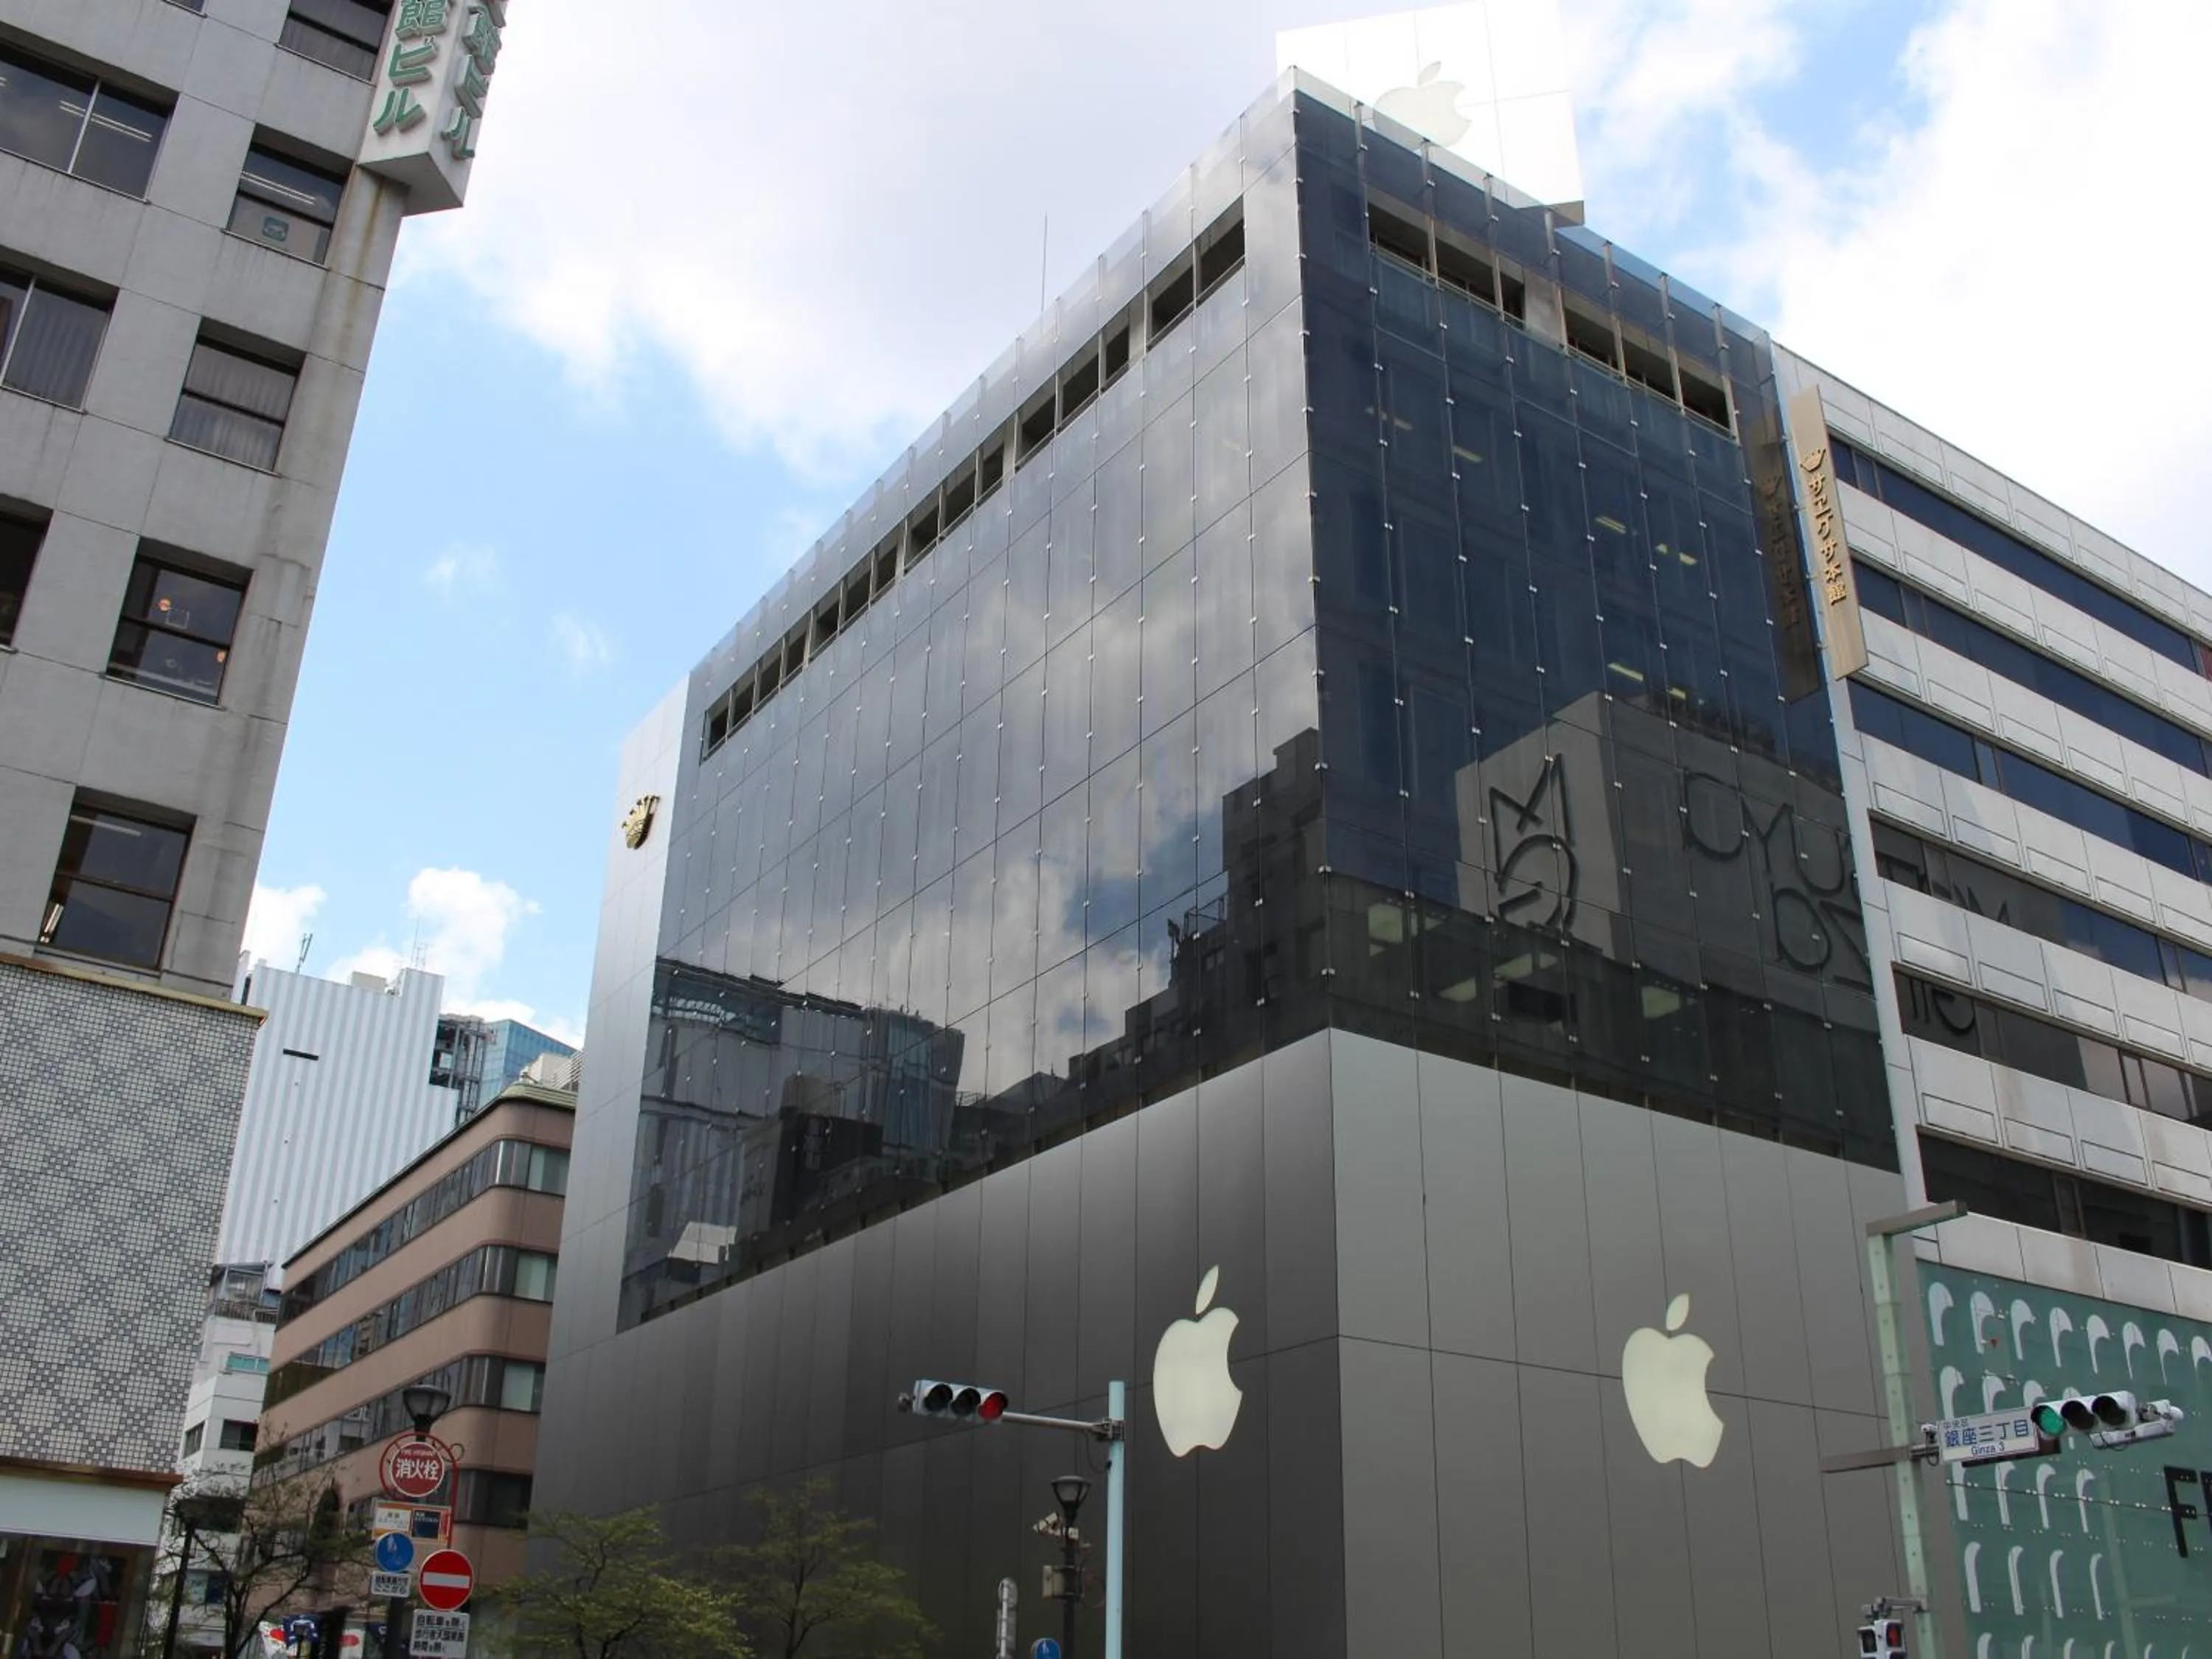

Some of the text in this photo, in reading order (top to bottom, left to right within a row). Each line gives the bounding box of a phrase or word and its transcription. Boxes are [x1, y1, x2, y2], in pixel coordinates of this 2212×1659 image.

[1946, 1419, 2029, 1447] 銀座三丁目
[1971, 1440, 2006, 1455] Ginza 3
[396, 1458, 439, 1480] 消火栓
